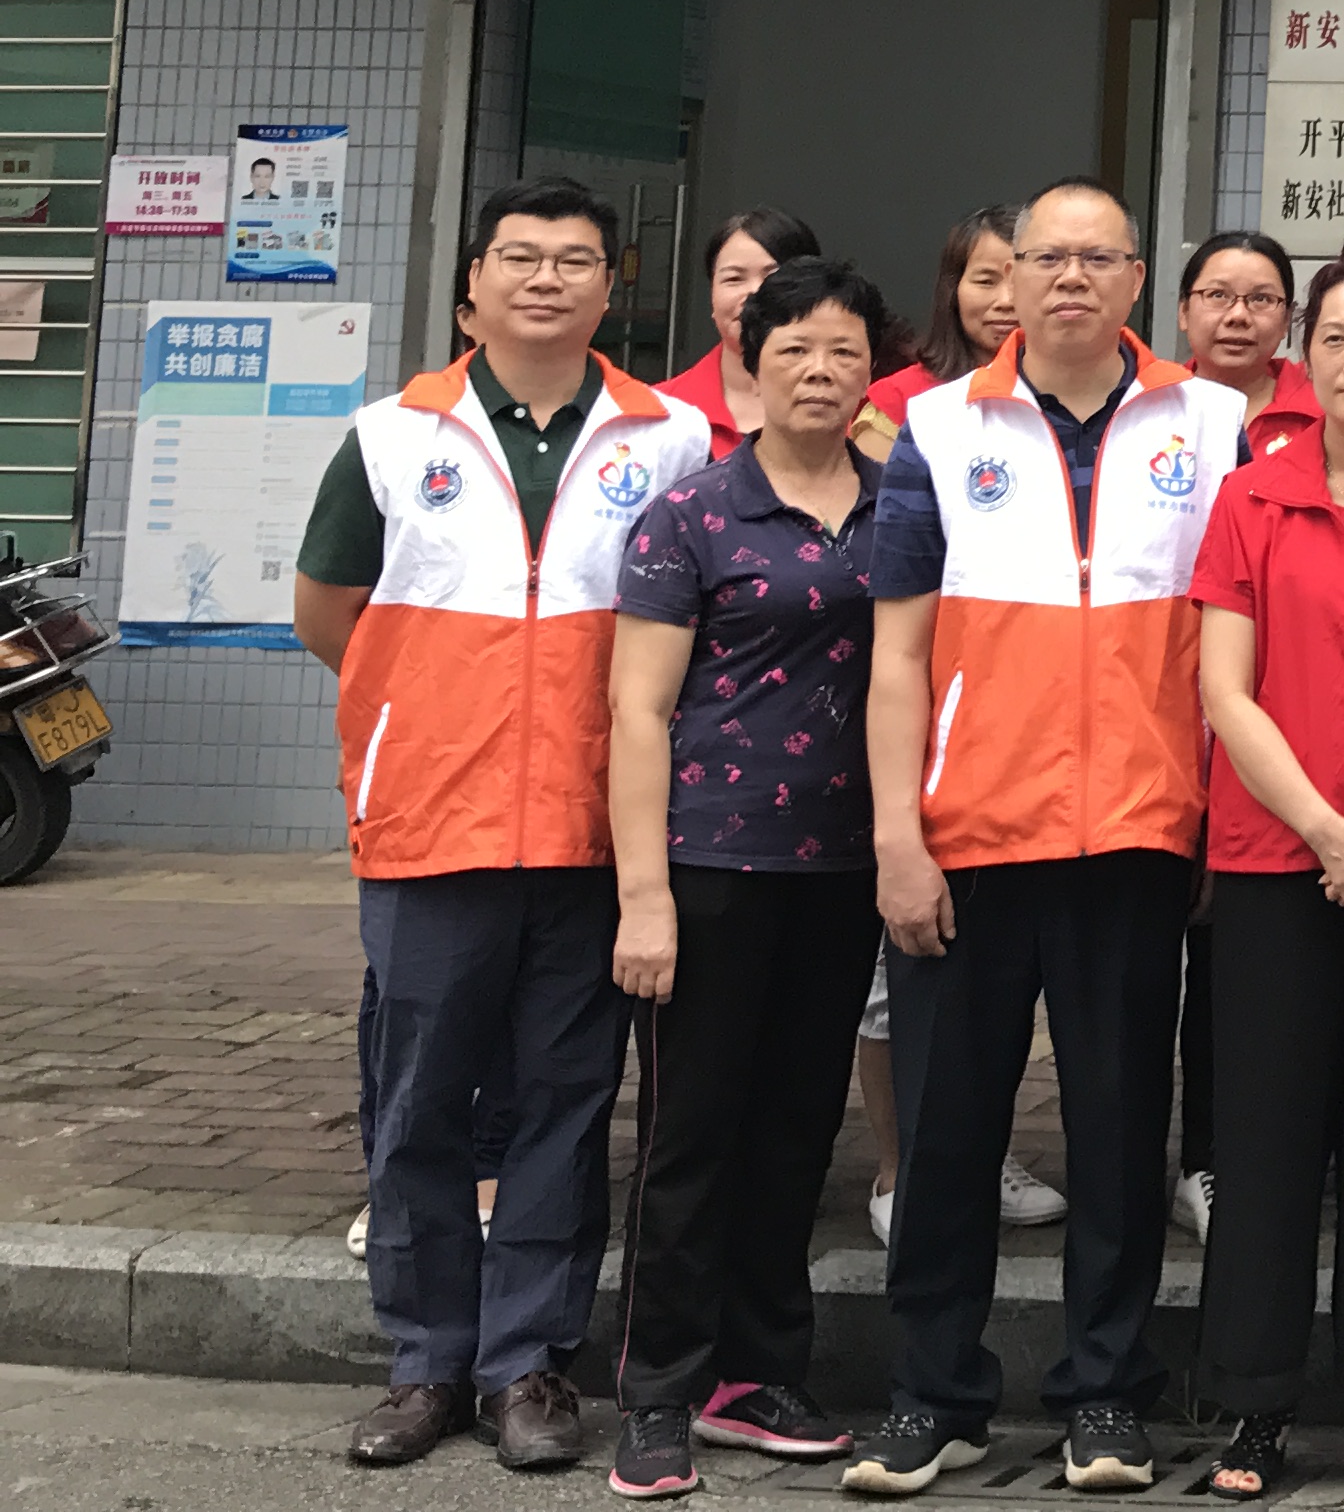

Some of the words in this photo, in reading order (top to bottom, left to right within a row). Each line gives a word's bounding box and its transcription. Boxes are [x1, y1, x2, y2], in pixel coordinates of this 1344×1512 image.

[138, 171, 201, 185] 开放时间
[167, 322, 266, 349] 举报贪腐
[164, 352, 263, 378] 共创廉洁
